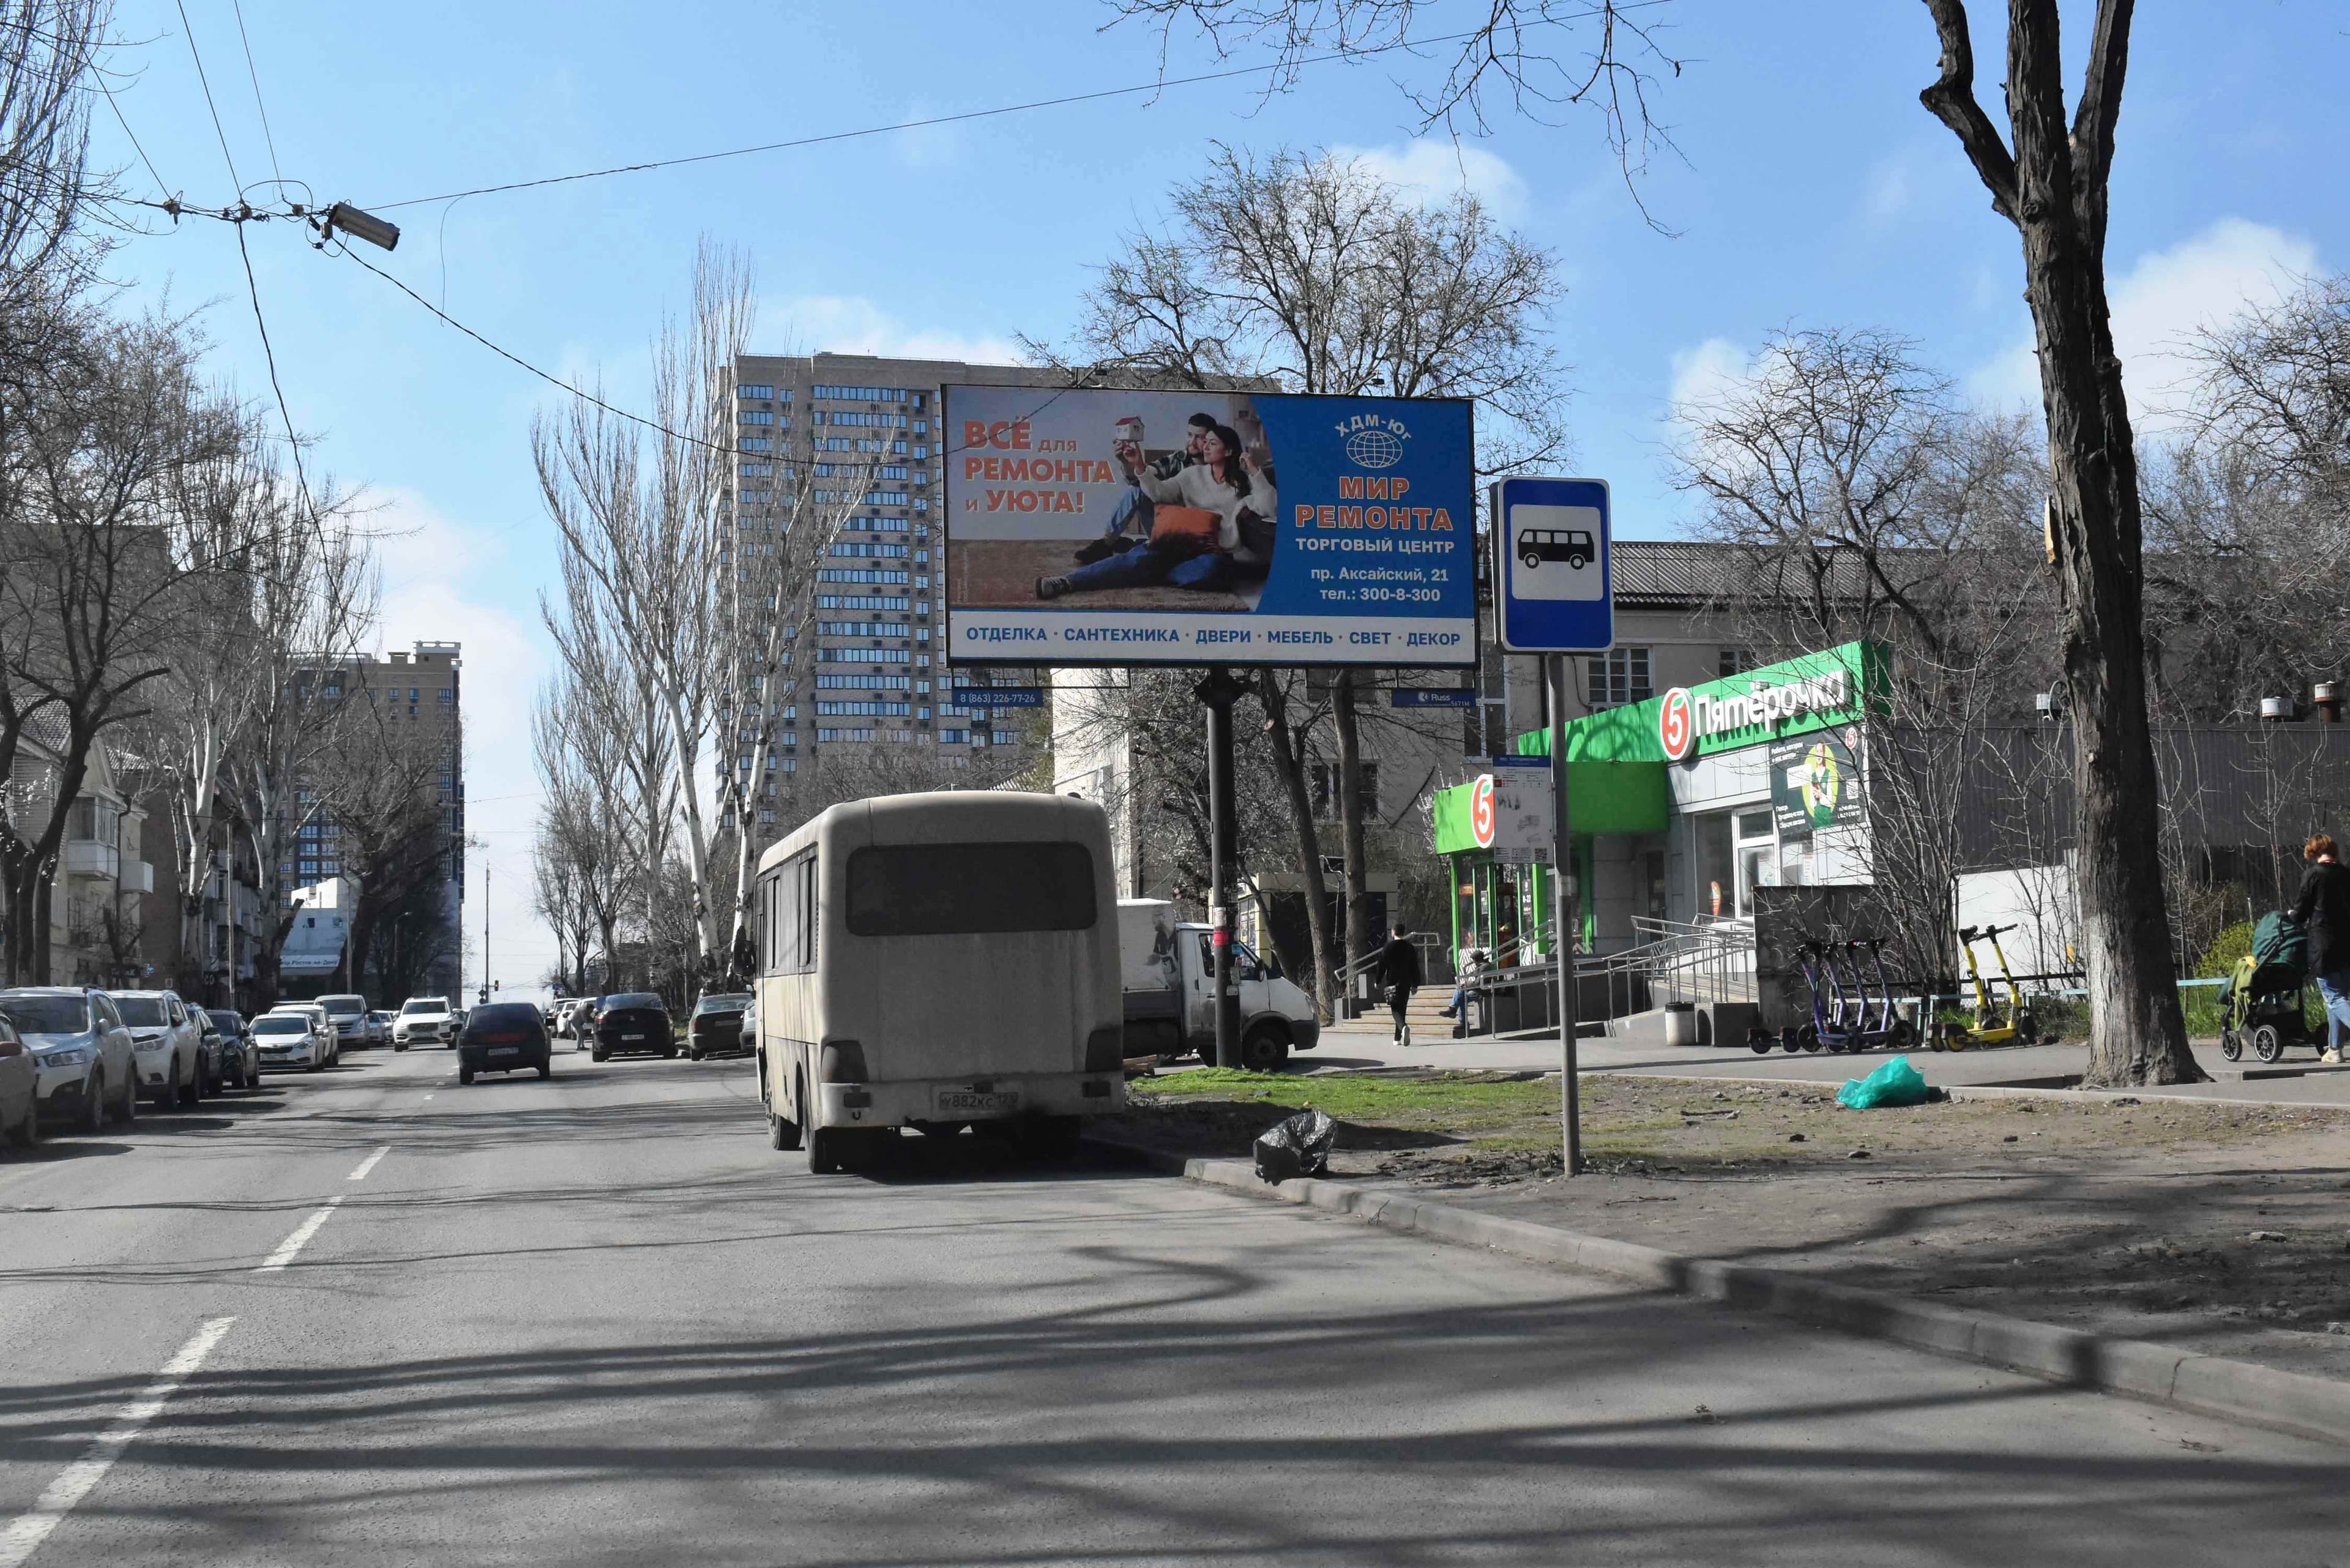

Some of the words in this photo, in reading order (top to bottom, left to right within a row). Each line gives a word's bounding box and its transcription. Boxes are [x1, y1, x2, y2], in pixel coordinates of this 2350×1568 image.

[964, 416, 1032, 450] ВСЁ
[1038, 439, 1078, 453] для
[965, 457, 1116, 484] РЕМОНТА
[1339, 476, 1409, 500] МИР
[966, 499, 979, 512] и
[986, 490, 1085, 514] УЮТА!
[1296, 504, 1454, 531] РЕМОНТА
[1296, 537, 1393, 552] ТОРГОВЫЙ
[1398, 540, 1455, 554] ЦЕНТР
[1311, 569, 1334, 582] пр.
[1338, 567, 1427, 583] Аксайский,
[1431, 569, 1449, 581] 21
[1320, 589, 1356, 600] тел.:
[1360, 588, 1441, 602] 300-8-300
[966, 627, 1048, 642] ОТДЕЛКА
[1064, 628, 1180, 642] САНТЕХНИКА
[1196, 630, 1251, 643] ДВЕРИ
[1267, 631, 1334, 644] МЕБЕЛЬ
[1349, 632, 1392, 644] СВЕТ
[1407, 632, 1461, 647] ДЕКОР
[960, 694, 966, 703] 8
[969, 693, 991, 704] (863)
[993, 694, 1035, 703] 226-77-26
[1695, 670, 1851, 736] Пятёрочка
